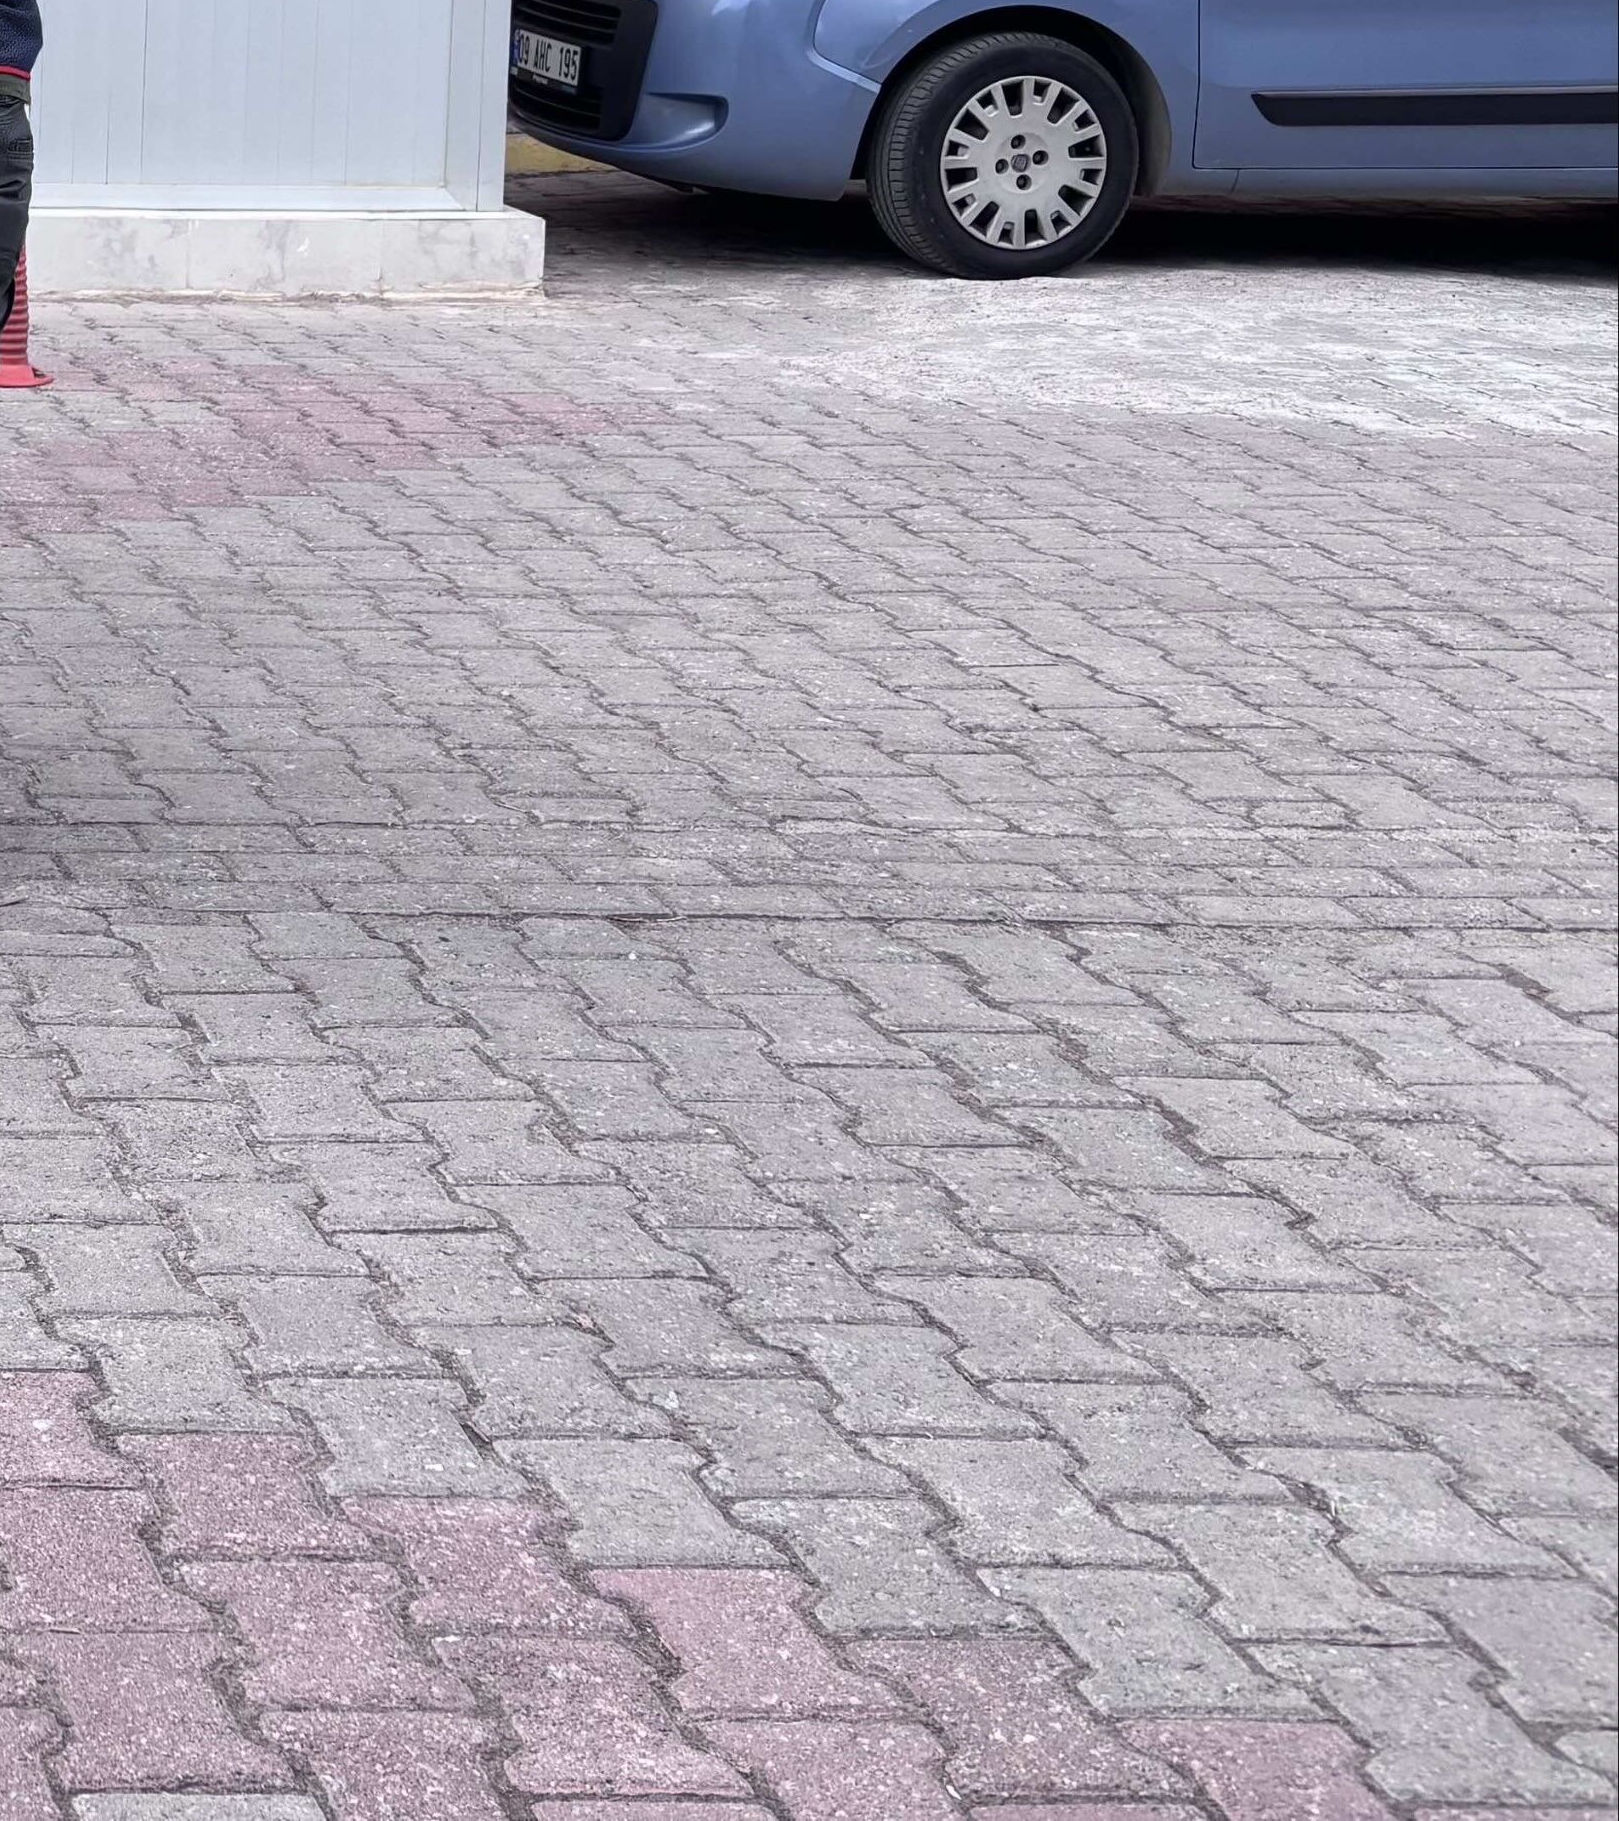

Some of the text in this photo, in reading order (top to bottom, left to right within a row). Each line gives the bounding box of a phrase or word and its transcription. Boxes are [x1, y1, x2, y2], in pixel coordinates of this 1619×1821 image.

[518, 33, 578, 81] 09 AHC 195
